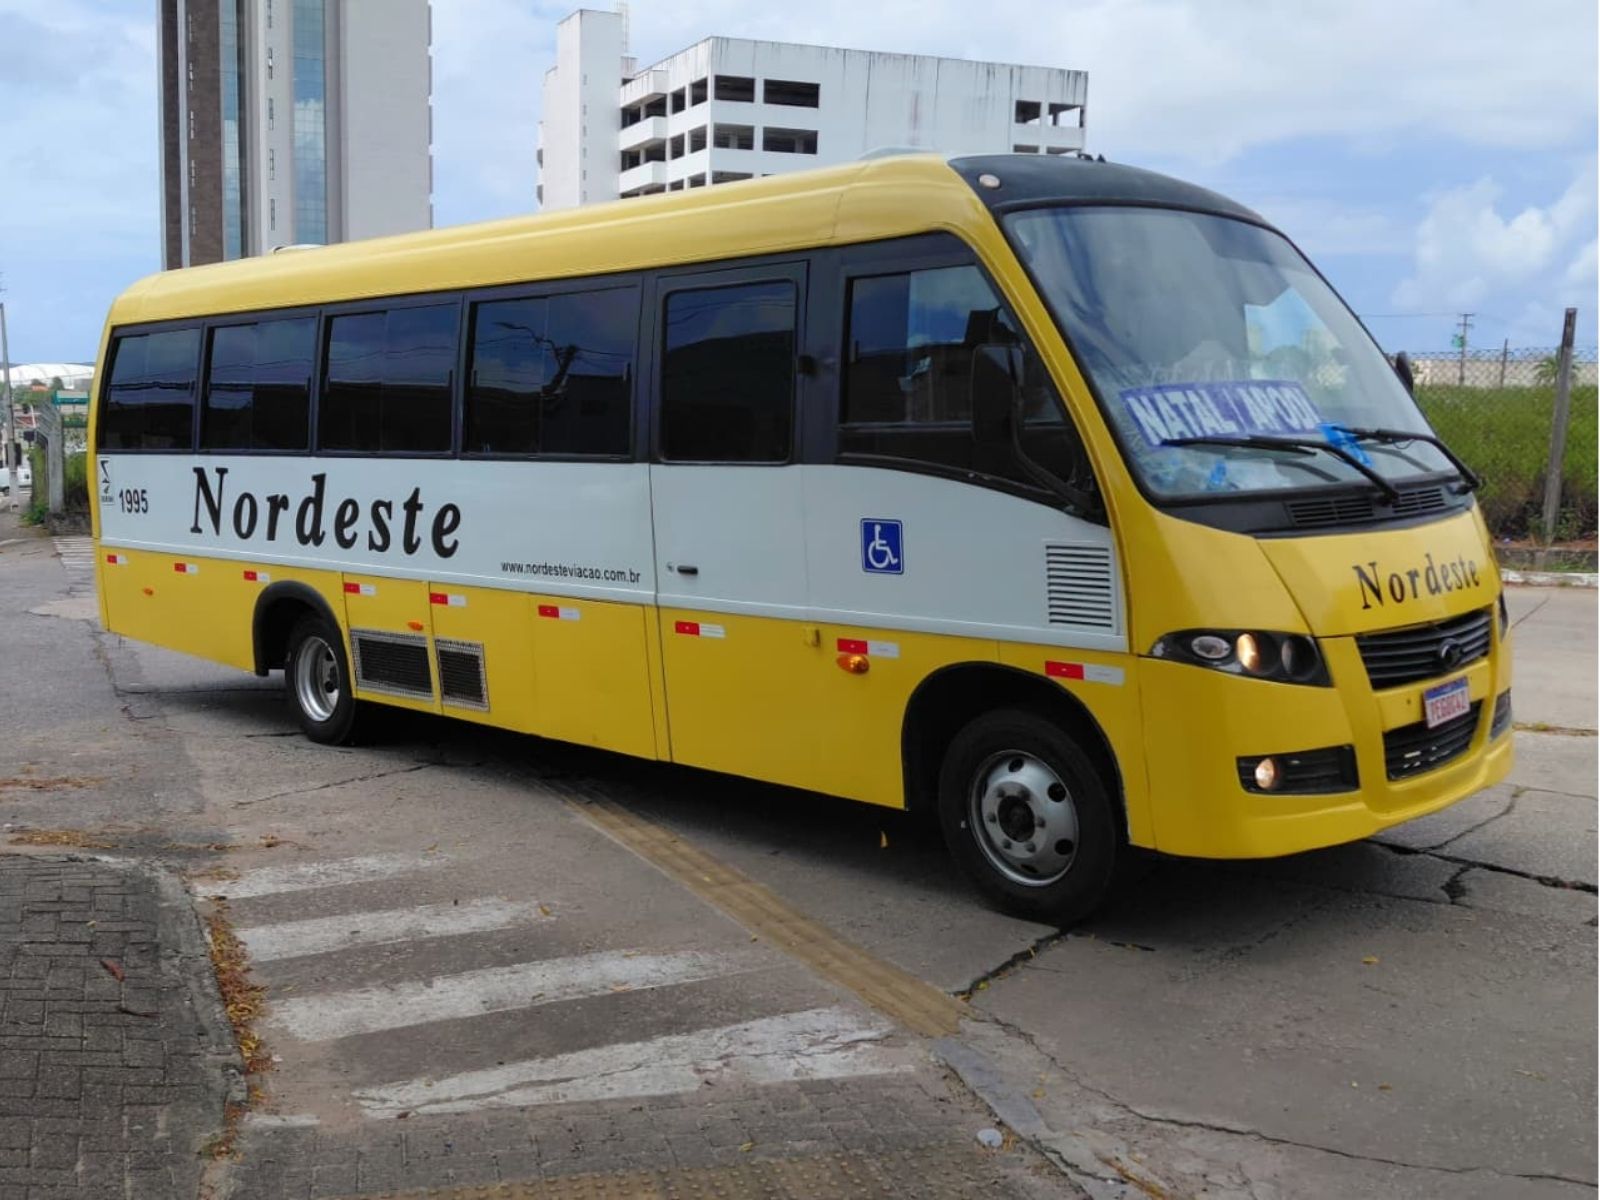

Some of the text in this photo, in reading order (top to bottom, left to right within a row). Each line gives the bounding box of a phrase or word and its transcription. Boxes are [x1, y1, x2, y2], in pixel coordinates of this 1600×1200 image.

[1126, 389, 1241, 446] NATAL
[1237, 385, 1322, 431] APODI
[118, 488, 149, 514] 1995
[191, 467, 461, 558] Nordeste
[501, 561, 641, 583] www.nordesteviacao.com.br
[1353, 553, 1480, 610] Nordeste
